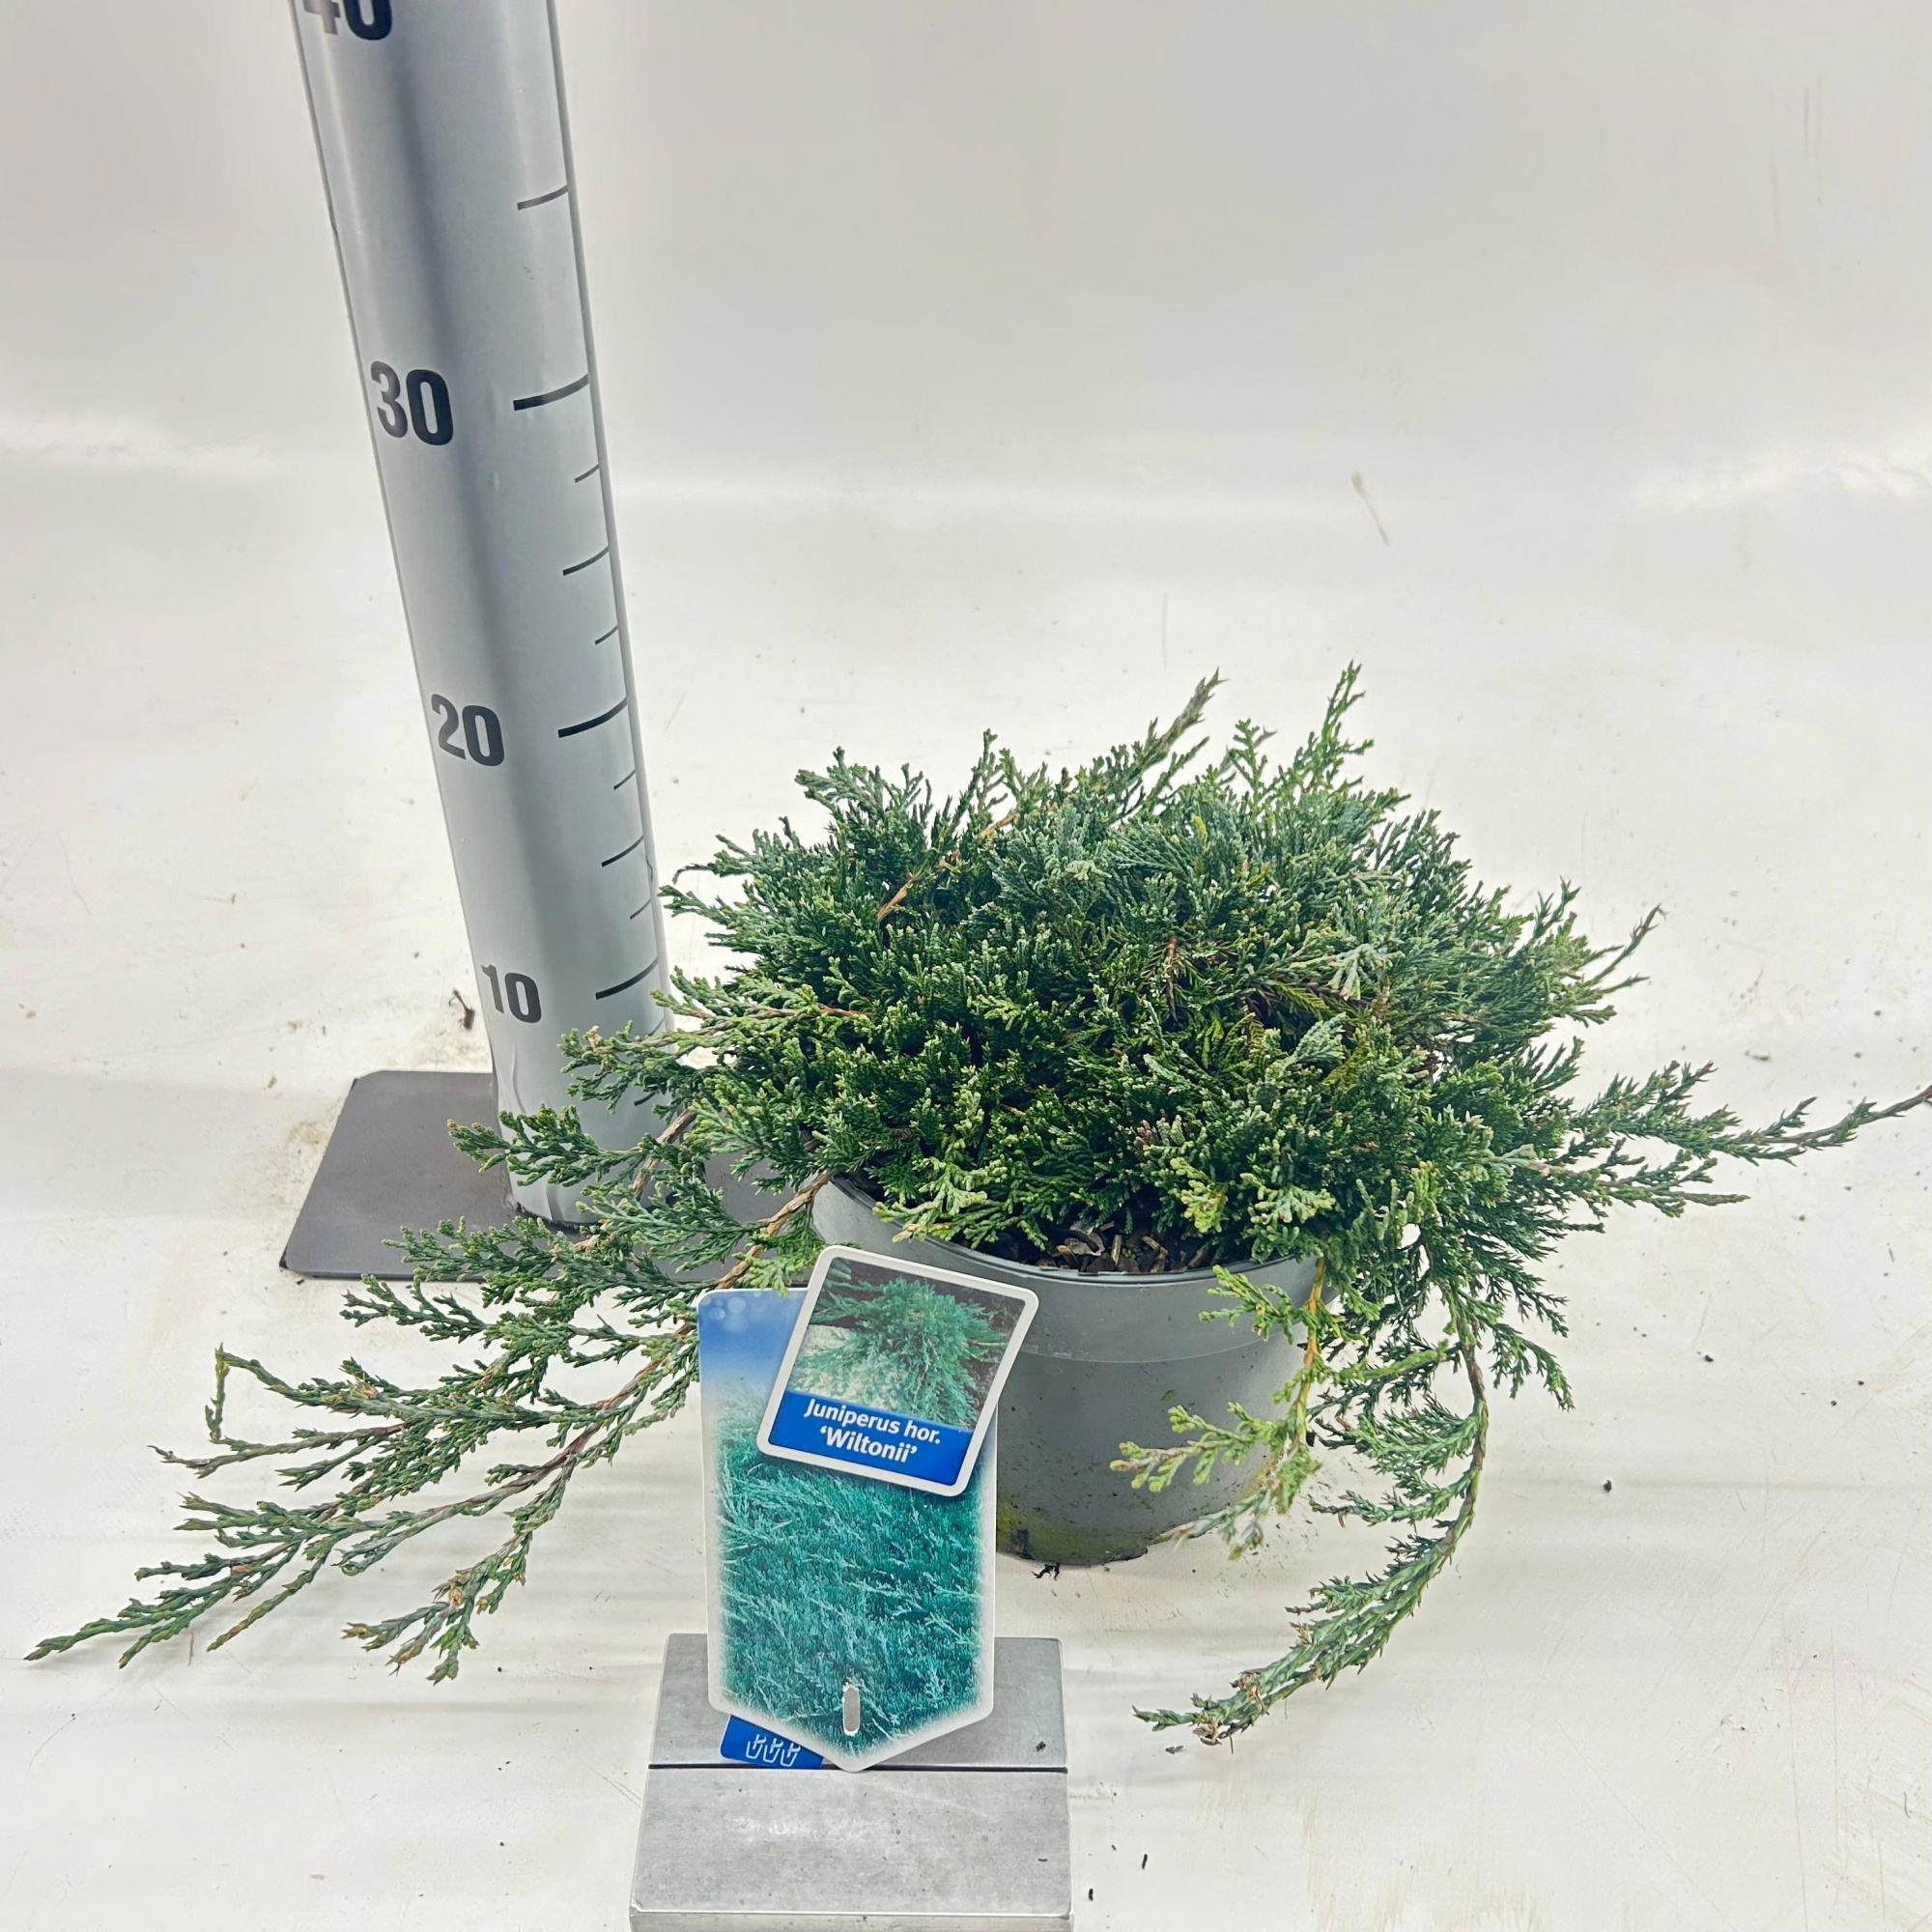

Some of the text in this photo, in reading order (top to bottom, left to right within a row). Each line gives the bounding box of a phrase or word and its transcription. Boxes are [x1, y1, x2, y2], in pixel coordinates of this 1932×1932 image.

[370, 360, 454, 445] 30
[431, 694, 504, 766] 20
[481, 964, 542, 1023] 10
[804, 1398, 941, 1444] Juniperus hor.
